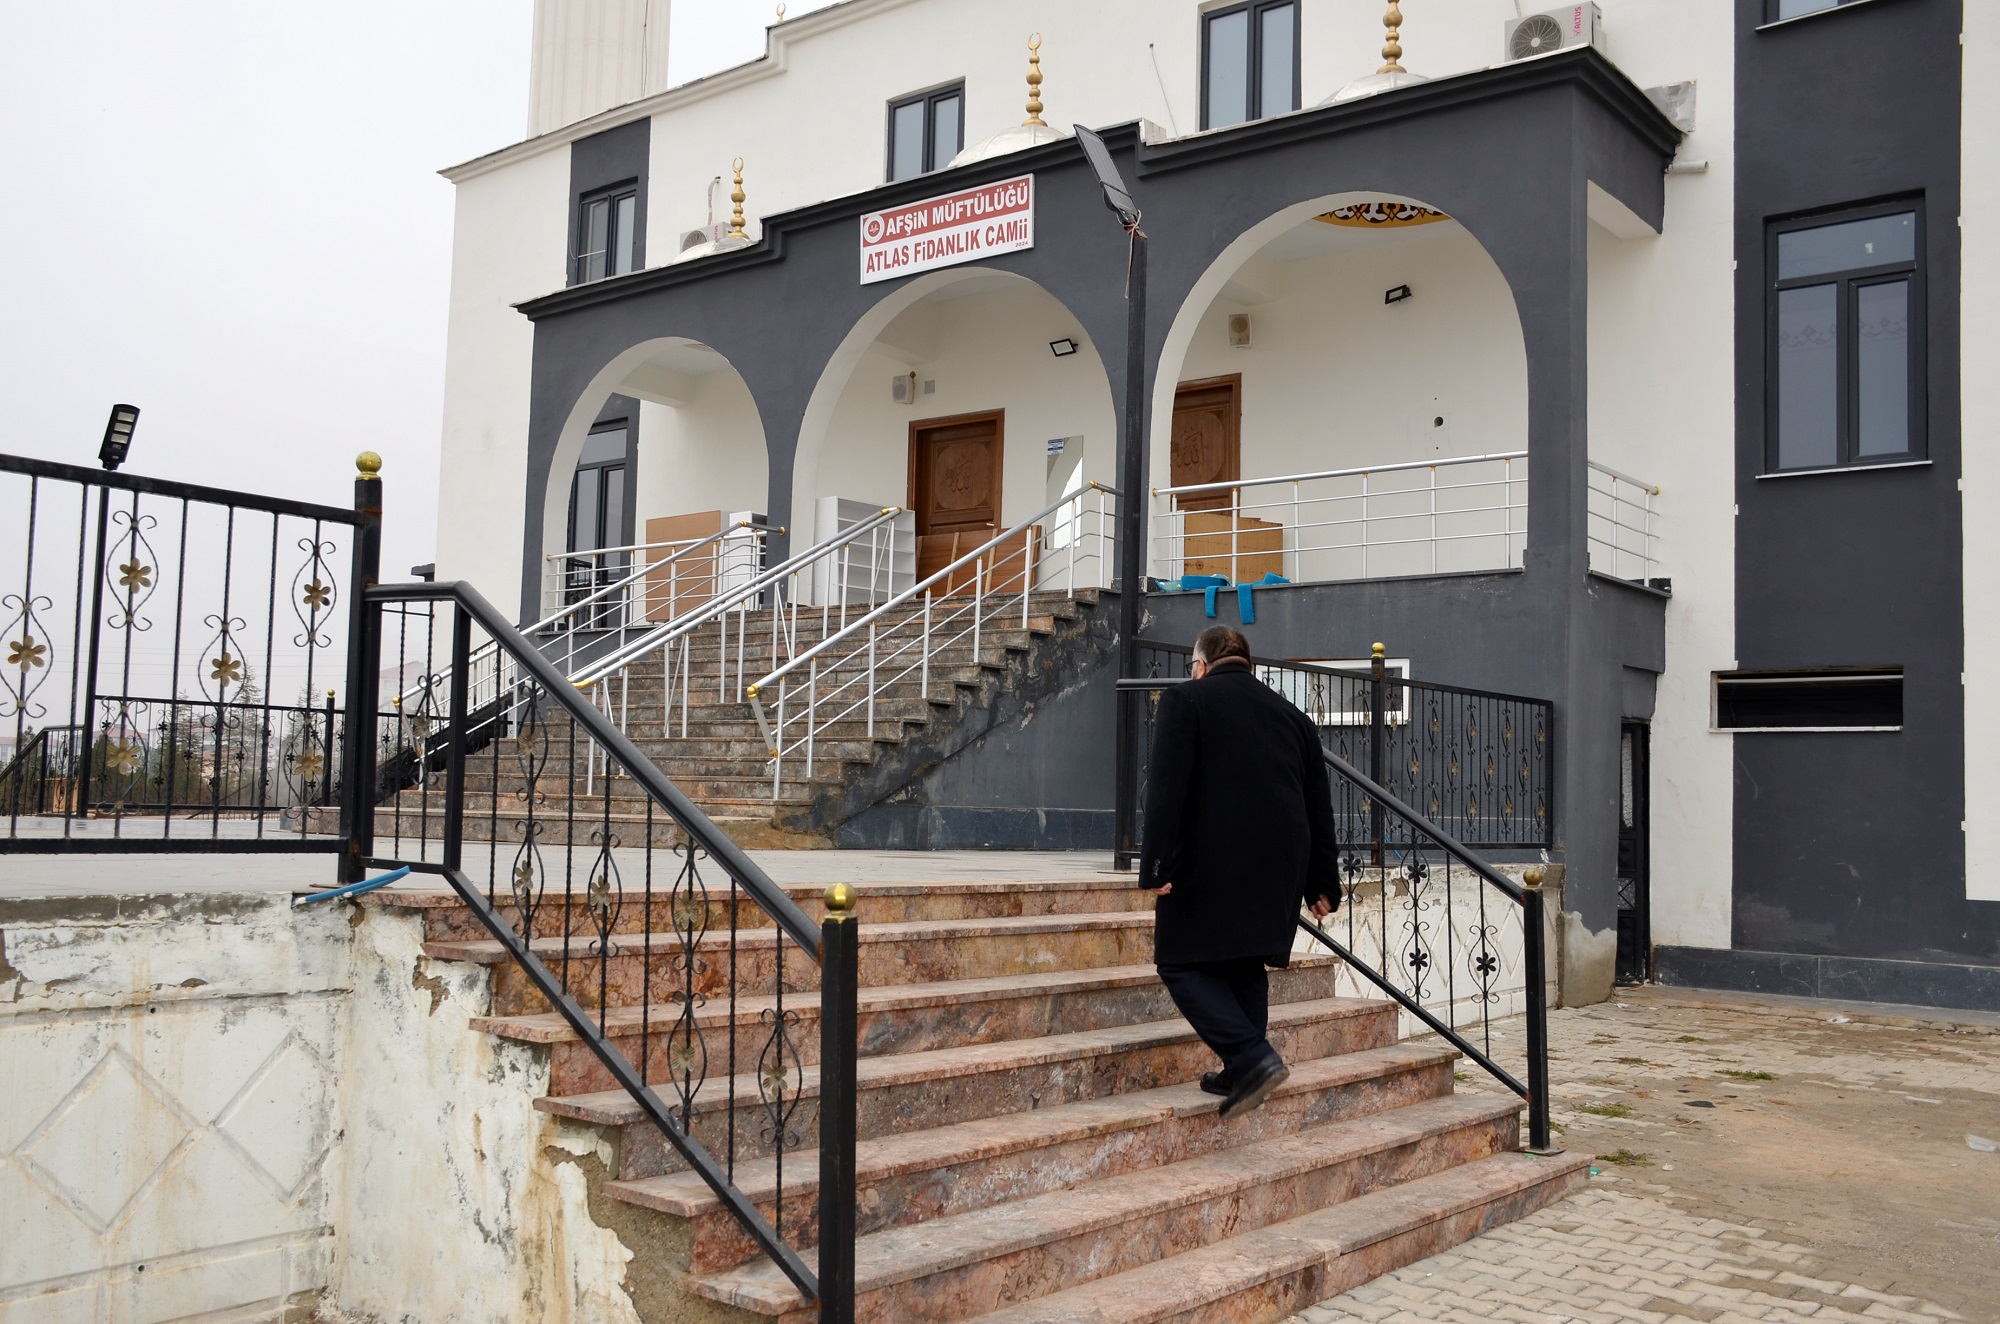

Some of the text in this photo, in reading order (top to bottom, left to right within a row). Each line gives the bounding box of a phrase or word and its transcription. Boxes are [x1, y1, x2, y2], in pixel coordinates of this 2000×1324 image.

[1574, 6, 1582, 30] ALTUS
[932, 182, 1028, 225] MÜFTÜLÜĞÜ
[866, 245, 909, 273] ATLAS
